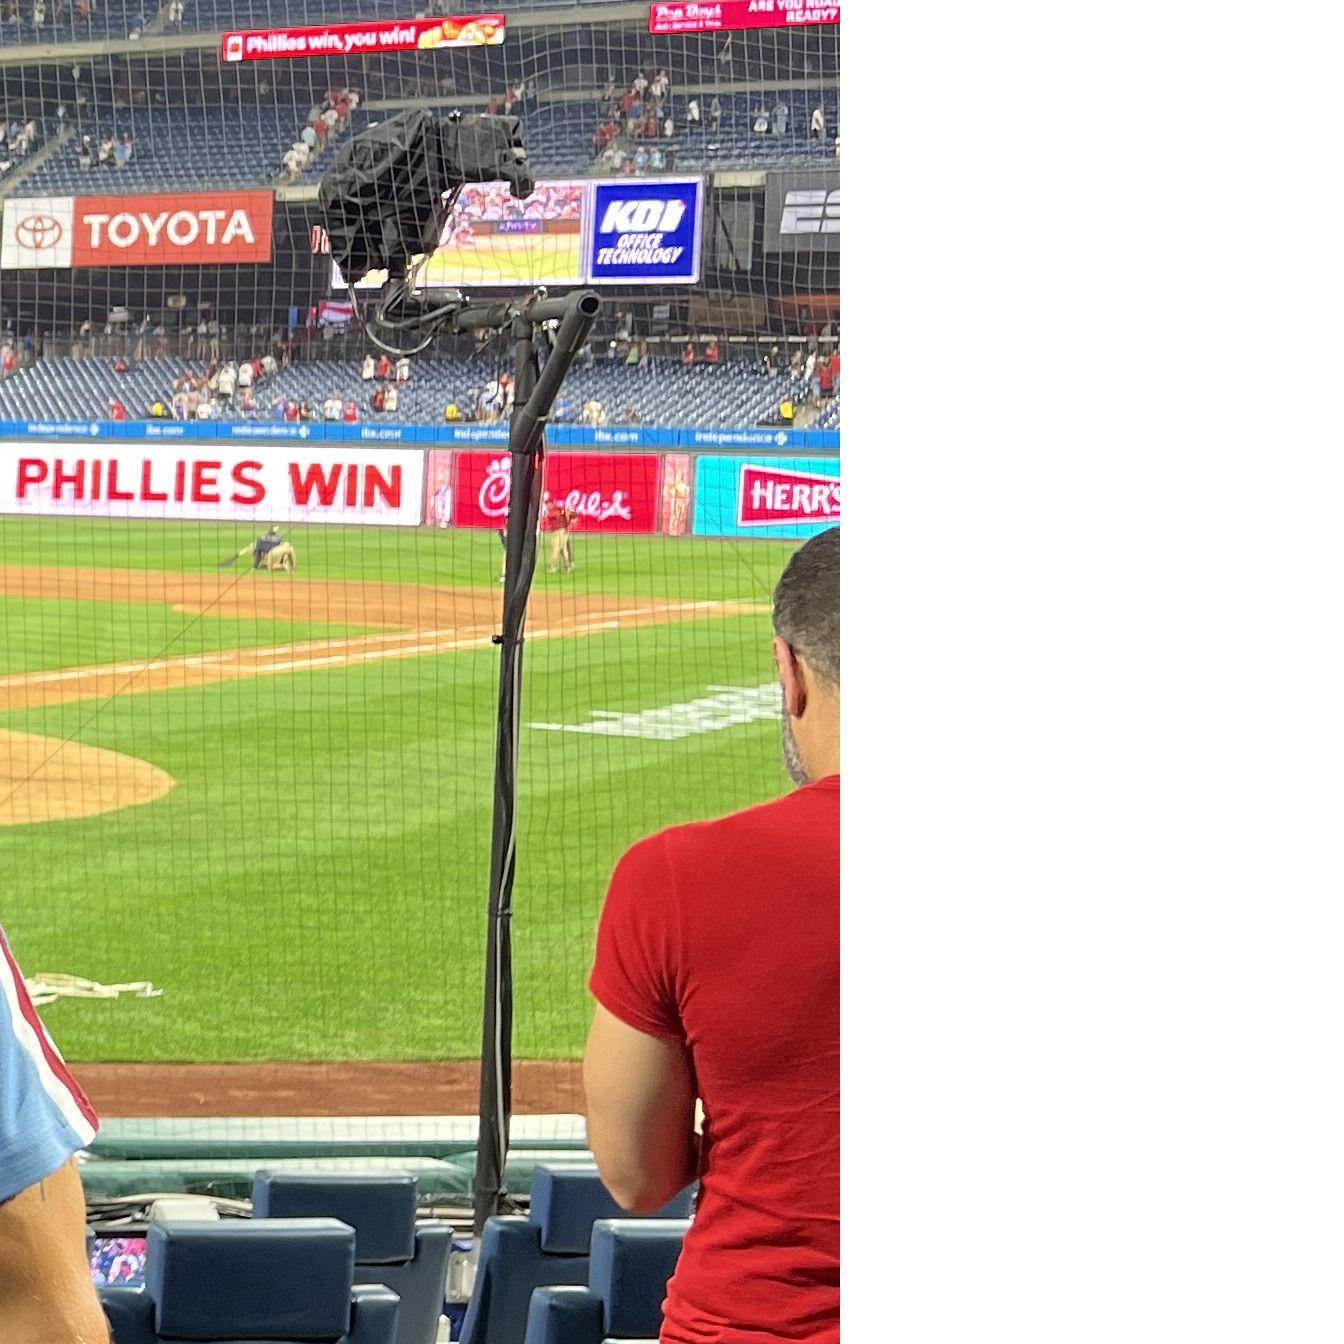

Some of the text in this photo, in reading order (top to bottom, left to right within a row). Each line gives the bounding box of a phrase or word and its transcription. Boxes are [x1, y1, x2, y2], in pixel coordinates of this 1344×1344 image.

[246, 33, 307, 54] Phillies
[343, 32, 377, 52] you
[82, 209, 256, 249] TOYOTA
[600, 198, 688, 234] KDI
[596, 244, 684, 266] TECHNOLOGY
[616, 232, 665, 251] OFFICE
[15, 458, 403, 508] PHILLIES WIN
